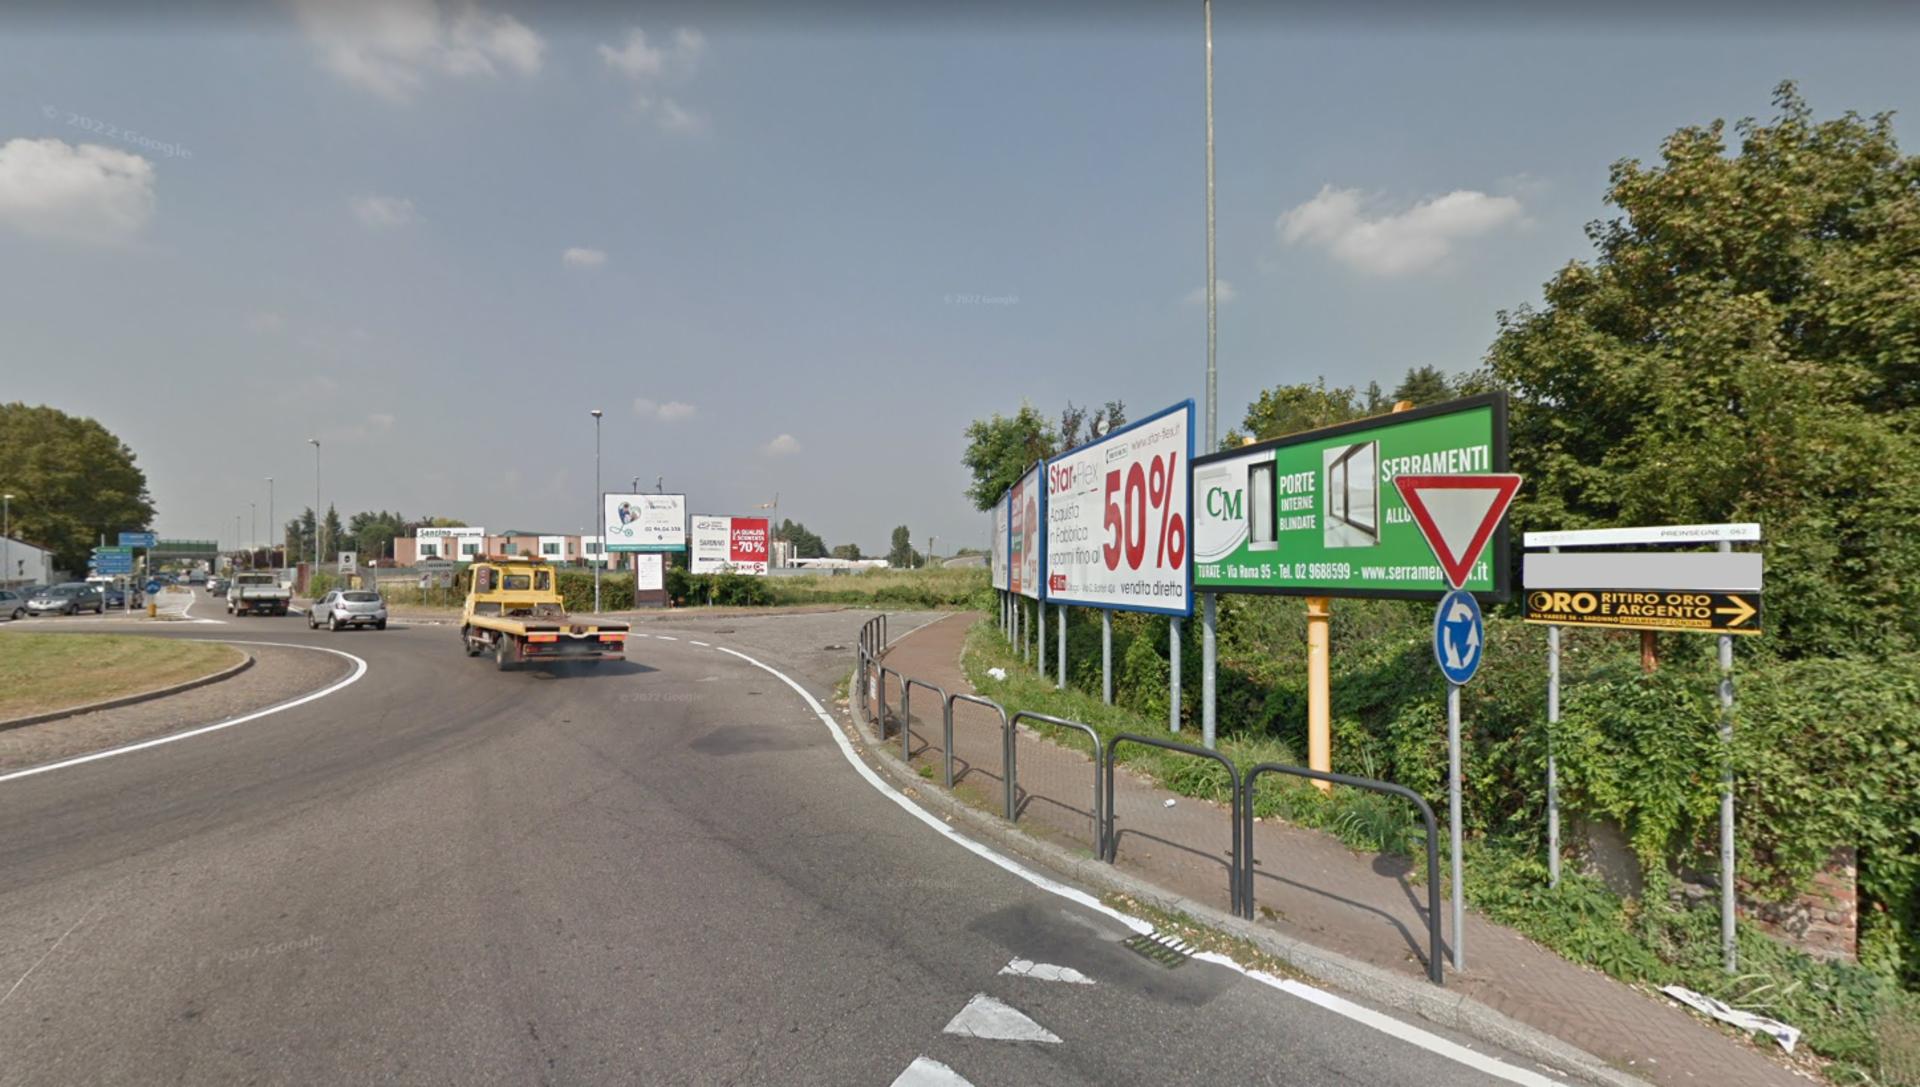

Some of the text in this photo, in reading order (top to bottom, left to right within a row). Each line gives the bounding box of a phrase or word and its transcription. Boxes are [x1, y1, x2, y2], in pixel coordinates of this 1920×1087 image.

[1382, 445, 1488, 482] SERRAMENTI
[1280, 471, 1316, 495] PORTE
[1103, 451, 1186, 571] 50%
[1207, 487, 1243, 521] CM
[1281, 495, 1314, 511] INTERNE
[1280, 515, 1316, 531] BLINDATE
[1386, 507, 1413, 524] ALLU
[1198, 565, 1221, 579] TURATE
[1227, 564, 1238, 579] Via
[1239, 565, 1259, 579] Roma
[1278, 563, 1292, 579] Tel.
[1295, 563, 1306, 579] 02
[1308, 562, 1350, 580] 9688599
[1120, 580, 1151, 596] vendita
[1152, 581, 1183, 597] diretta
[1529, 591, 1598, 614] ORO
[1601, 593, 1711, 606] RITIRO ORO
[1601, 604, 1711, 619] E ARGENTO
